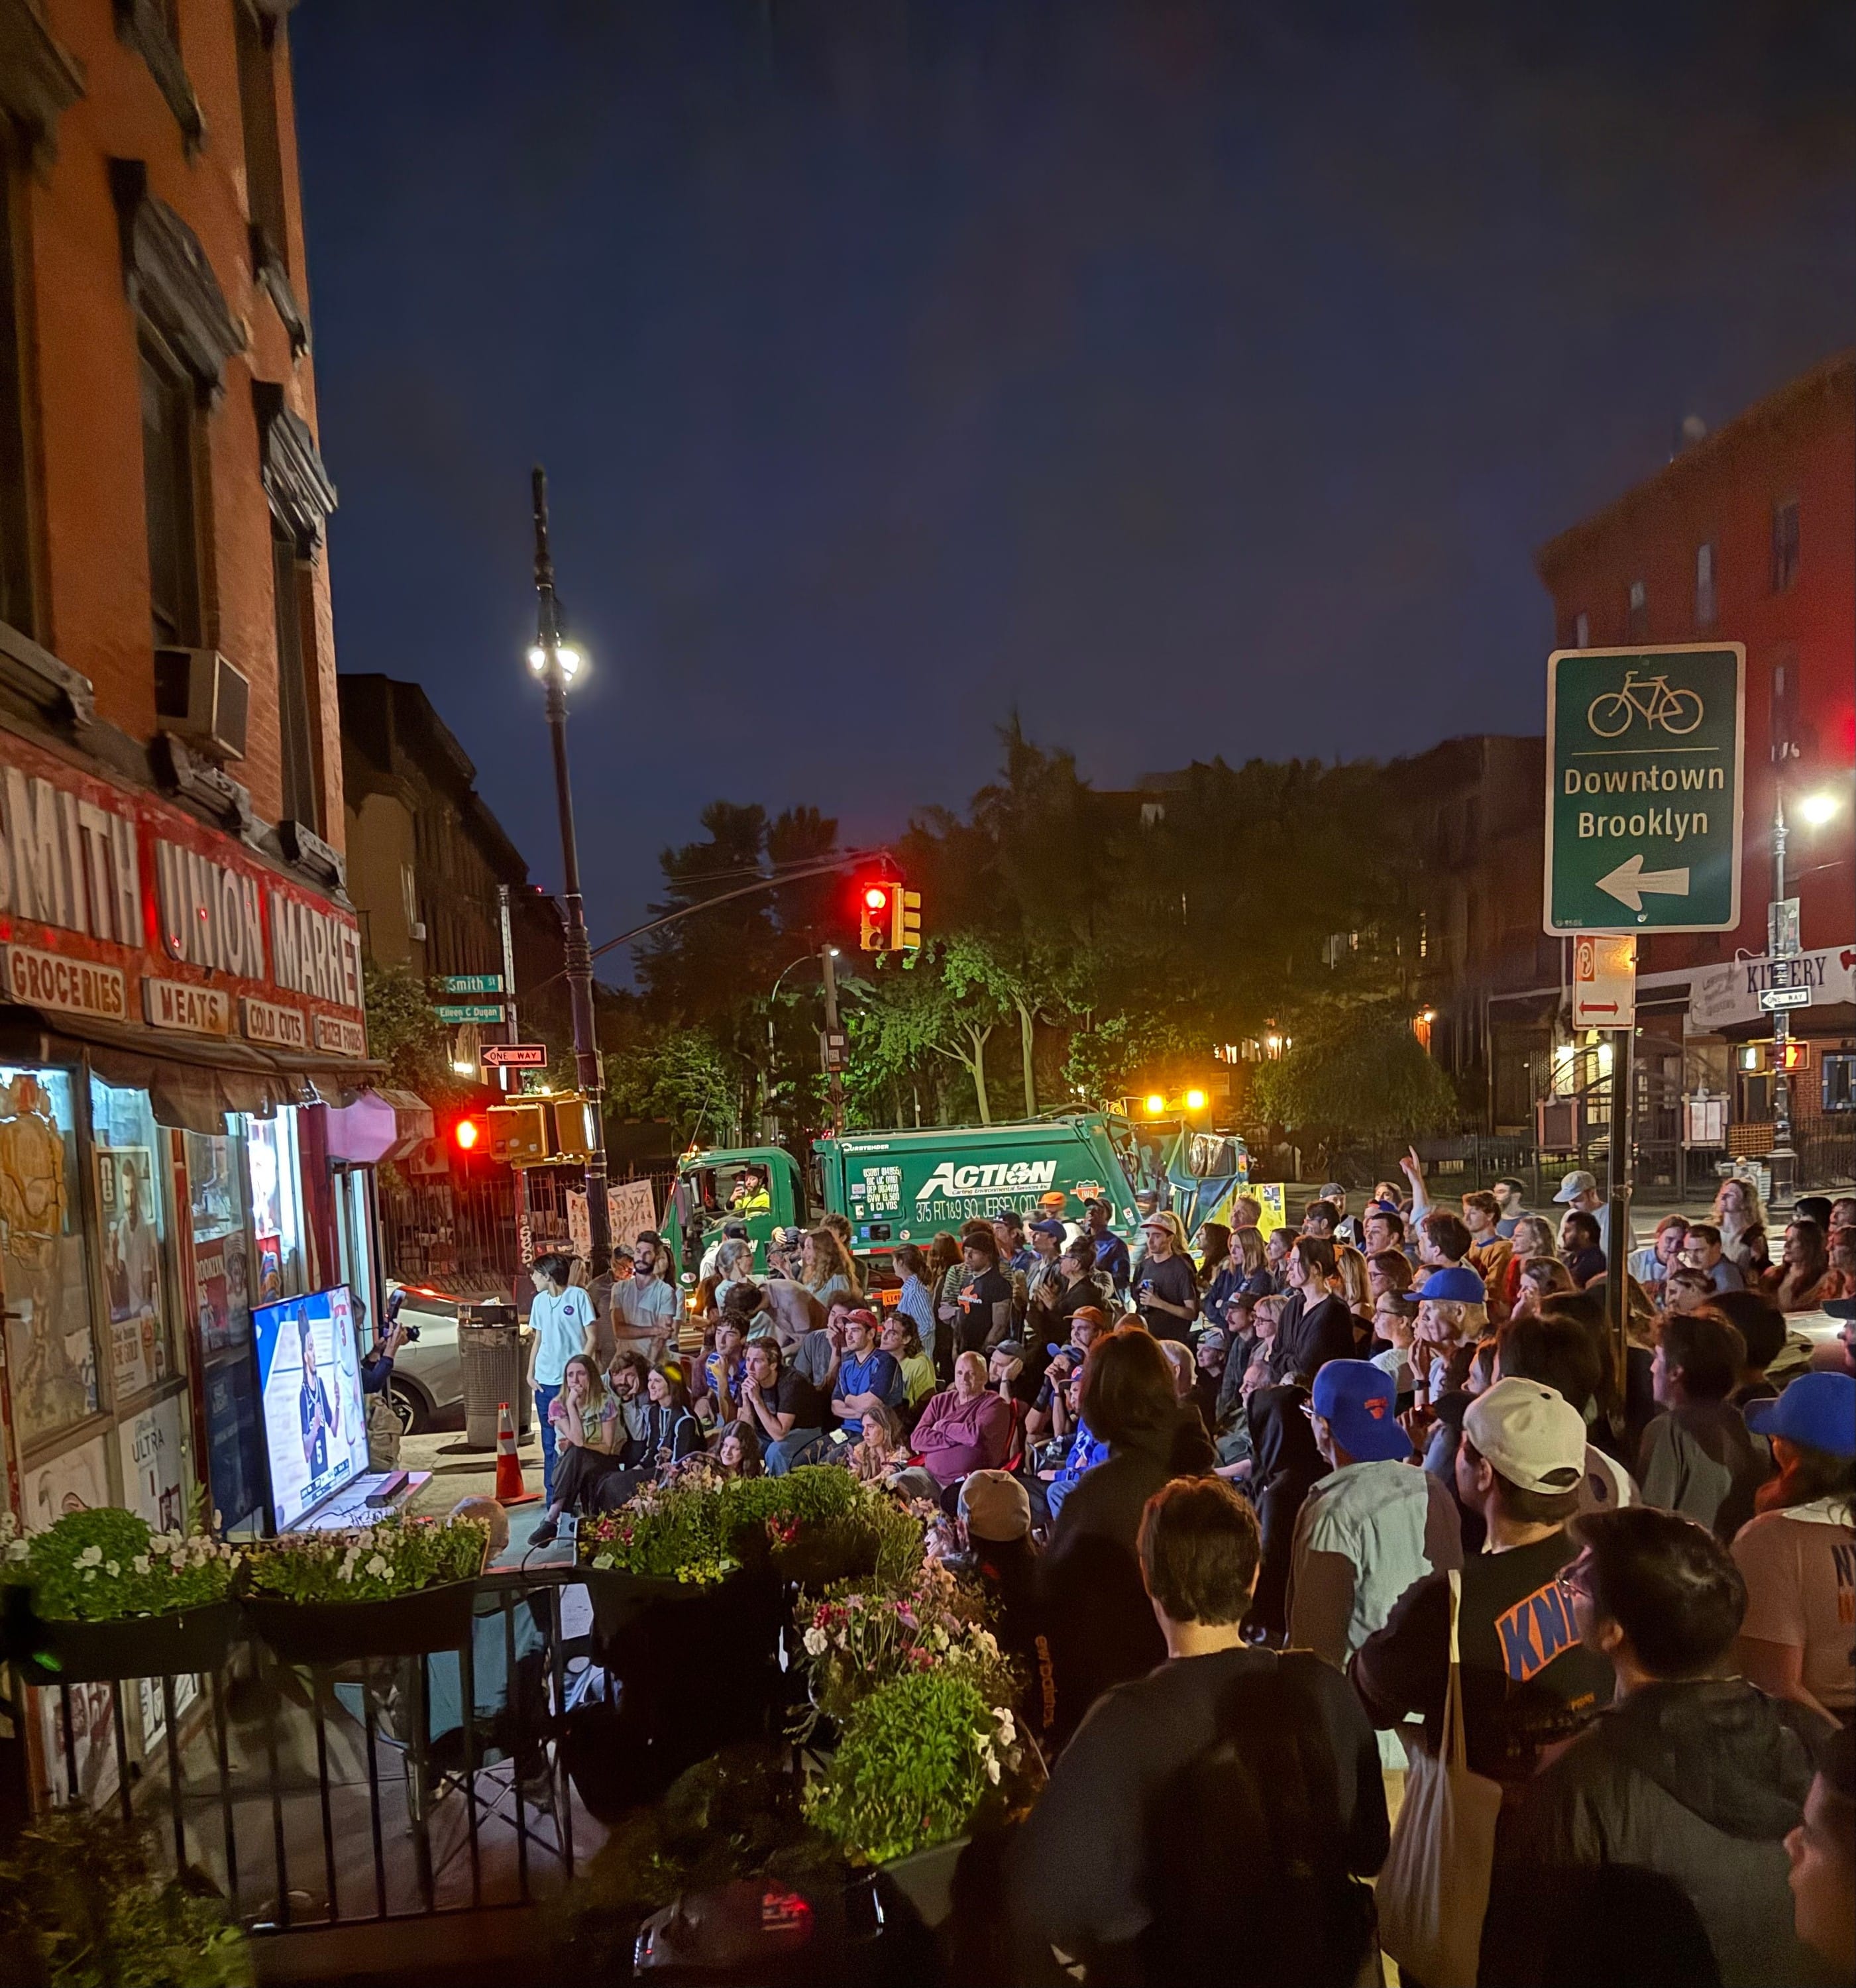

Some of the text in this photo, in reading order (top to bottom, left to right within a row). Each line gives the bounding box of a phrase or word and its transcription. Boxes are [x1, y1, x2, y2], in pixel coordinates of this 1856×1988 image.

[1564, 765, 1723, 794] Downtown
[1578, 808, 1708, 842] Brooklyn
[0, 765, 362, 1011] MITH UNION MARKET
[12, 951, 121, 1013] GROCERIES
[449, 977, 496, 991] Smith St
[1747, 957, 1827, 993] KITERY
[160, 985, 219, 1029] MEATS
[250, 1004, 301, 1042] COLD CUTS
[440, 1008, 463, 1017] Eileen
[474, 1007, 497, 1018] Dugan
[863, 1168, 880, 1178] USDOT
[916, 1160, 1057, 1199] ACTION
[867, 1193, 881, 1203] GVW
[876, 1202, 885, 1211] CU
[886, 1201, 898, 1210] YDS
[916, 1201, 932, 1223] 375
[983, 1196, 1016, 1218] JERSEY
[1020, 1195, 1040, 1215] CITY
[132, 1429, 165, 1463] ULTRA
